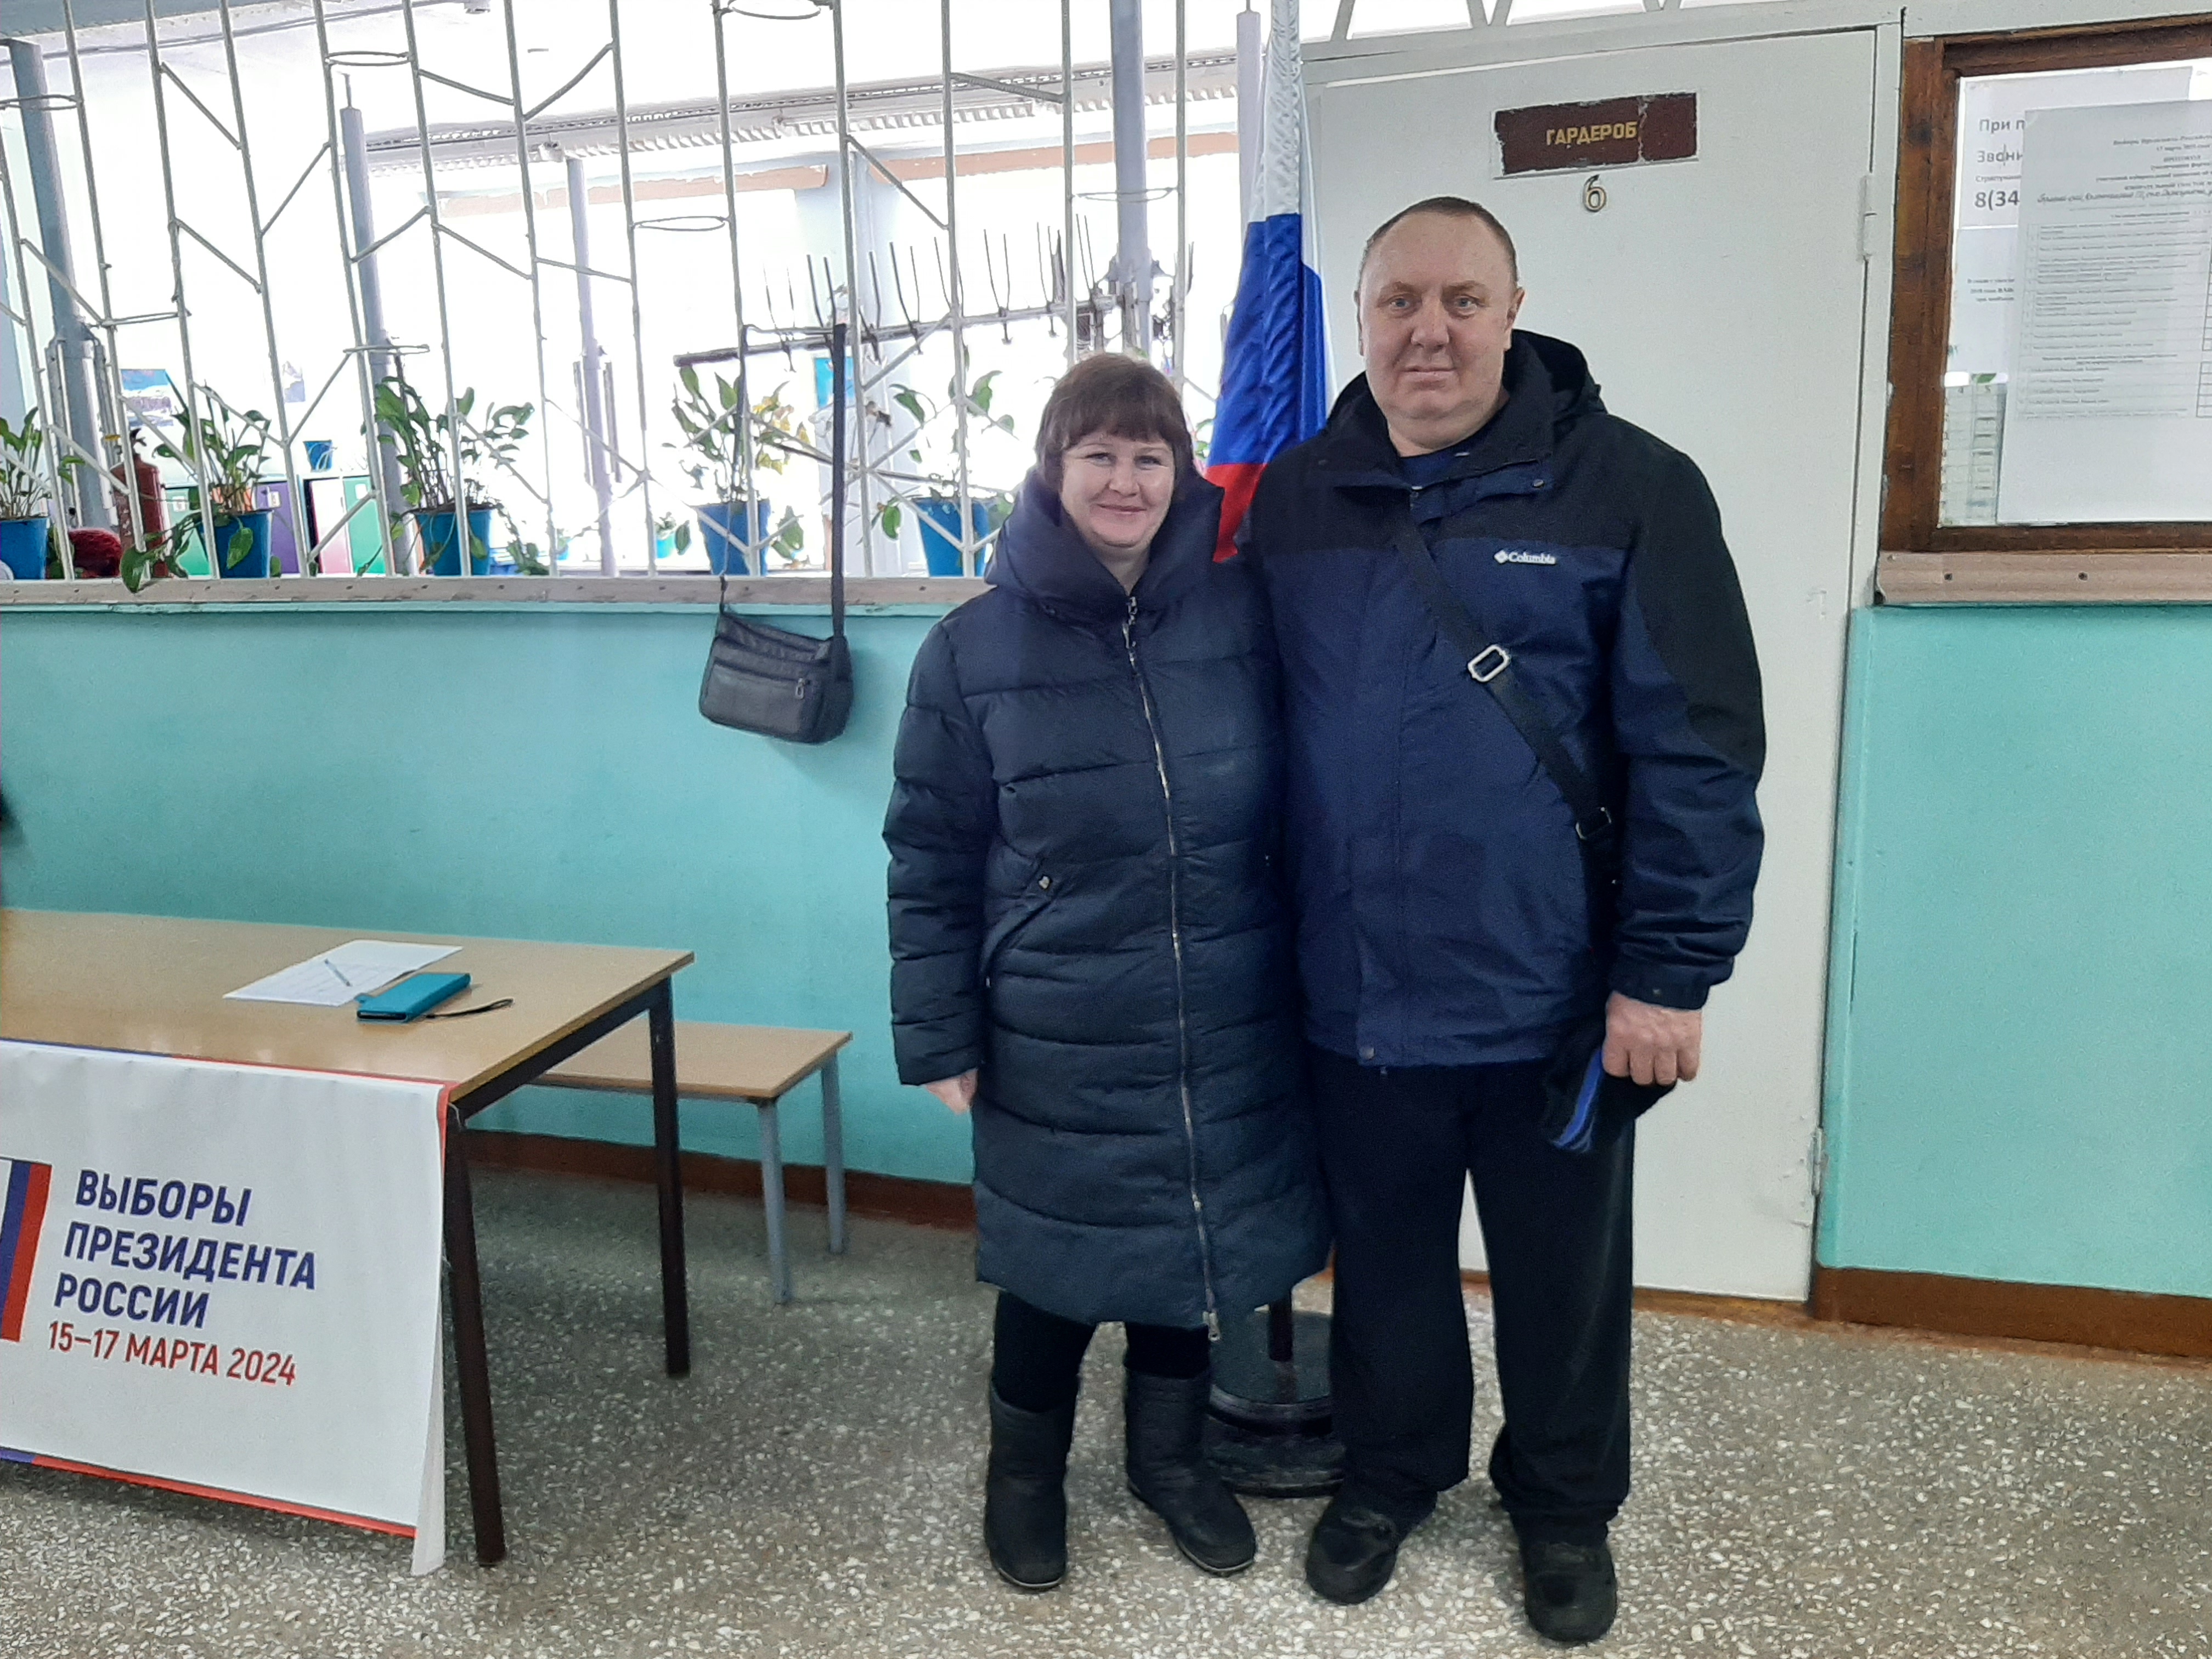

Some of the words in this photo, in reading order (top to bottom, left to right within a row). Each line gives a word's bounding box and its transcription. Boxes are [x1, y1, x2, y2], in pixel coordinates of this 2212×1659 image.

[1545, 121, 1638, 145] ГАРДЕРОБ
[1979, 119, 2011, 134] При
[1583, 174, 1607, 212] 6
[1509, 551, 1556, 565] Columbia
[76, 1169, 252, 1227] ВЫБОРЫ
[64, 1221, 316, 1290] ПРЕЗИДЕНТА
[54, 1272, 210, 1329] РОССИИ
[125, 1333, 219, 1376] МАРТА
[226, 1347, 297, 1386] 2024
